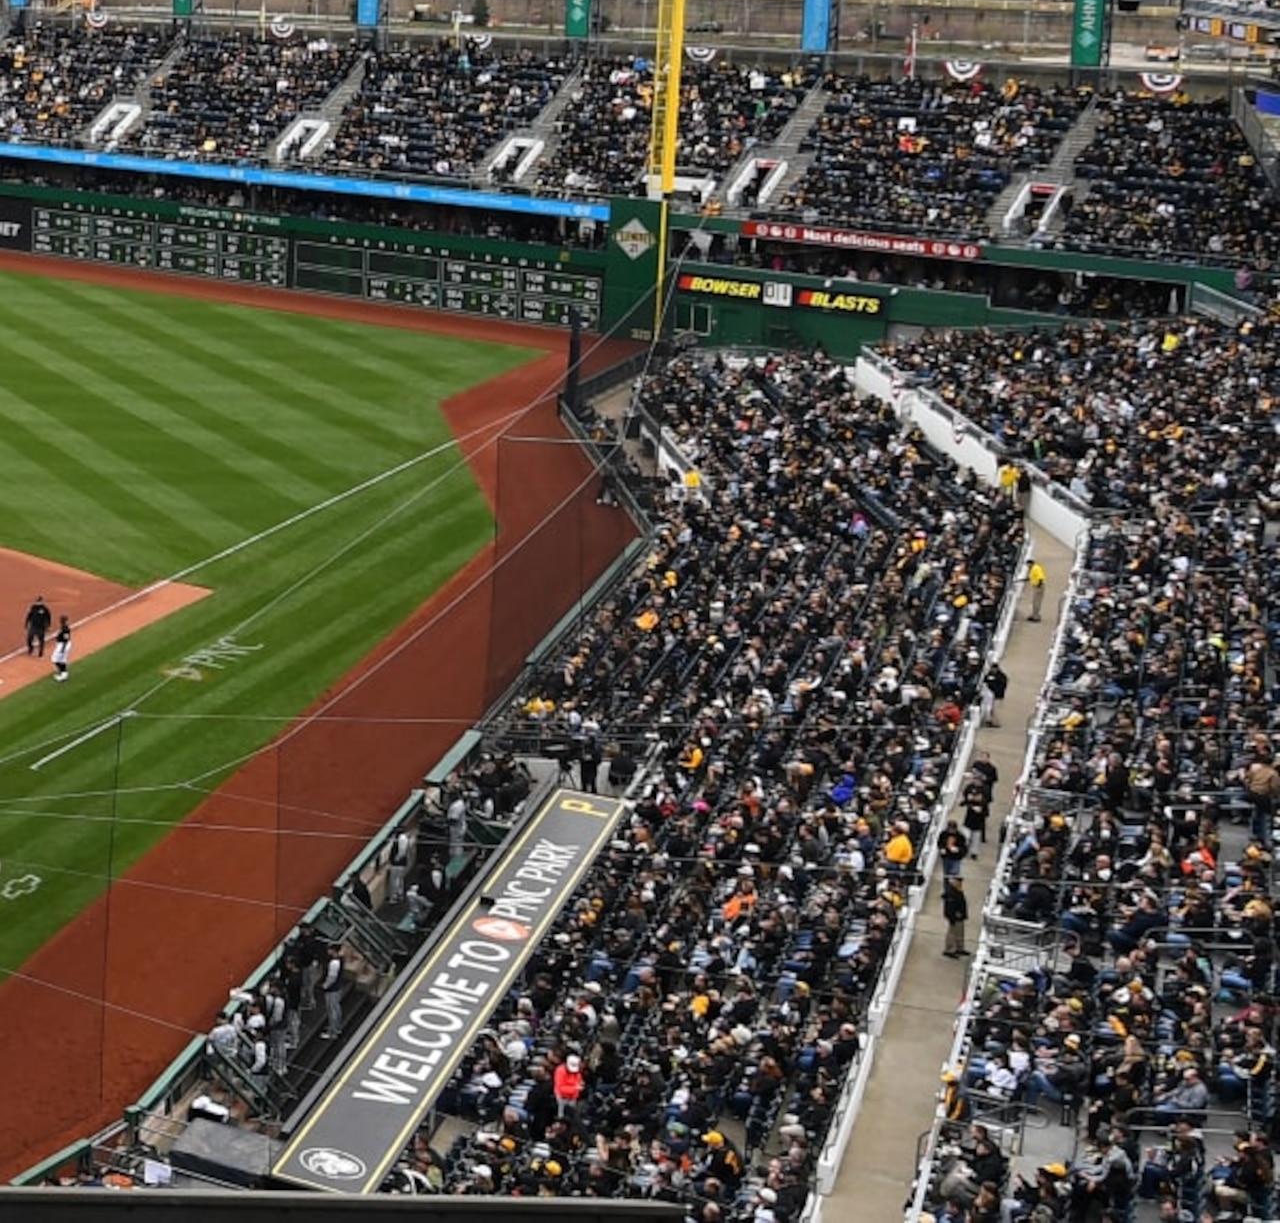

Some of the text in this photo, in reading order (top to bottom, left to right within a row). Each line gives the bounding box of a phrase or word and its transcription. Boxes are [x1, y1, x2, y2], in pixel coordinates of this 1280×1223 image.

[834, 232, 890, 249] delicious
[893, 239, 925, 252] seats
[691, 278, 761, 299] BOWSER
[811, 292, 880, 313] BLASTS
[352, 838, 580, 1105] WELCOME TO PNC PARK
